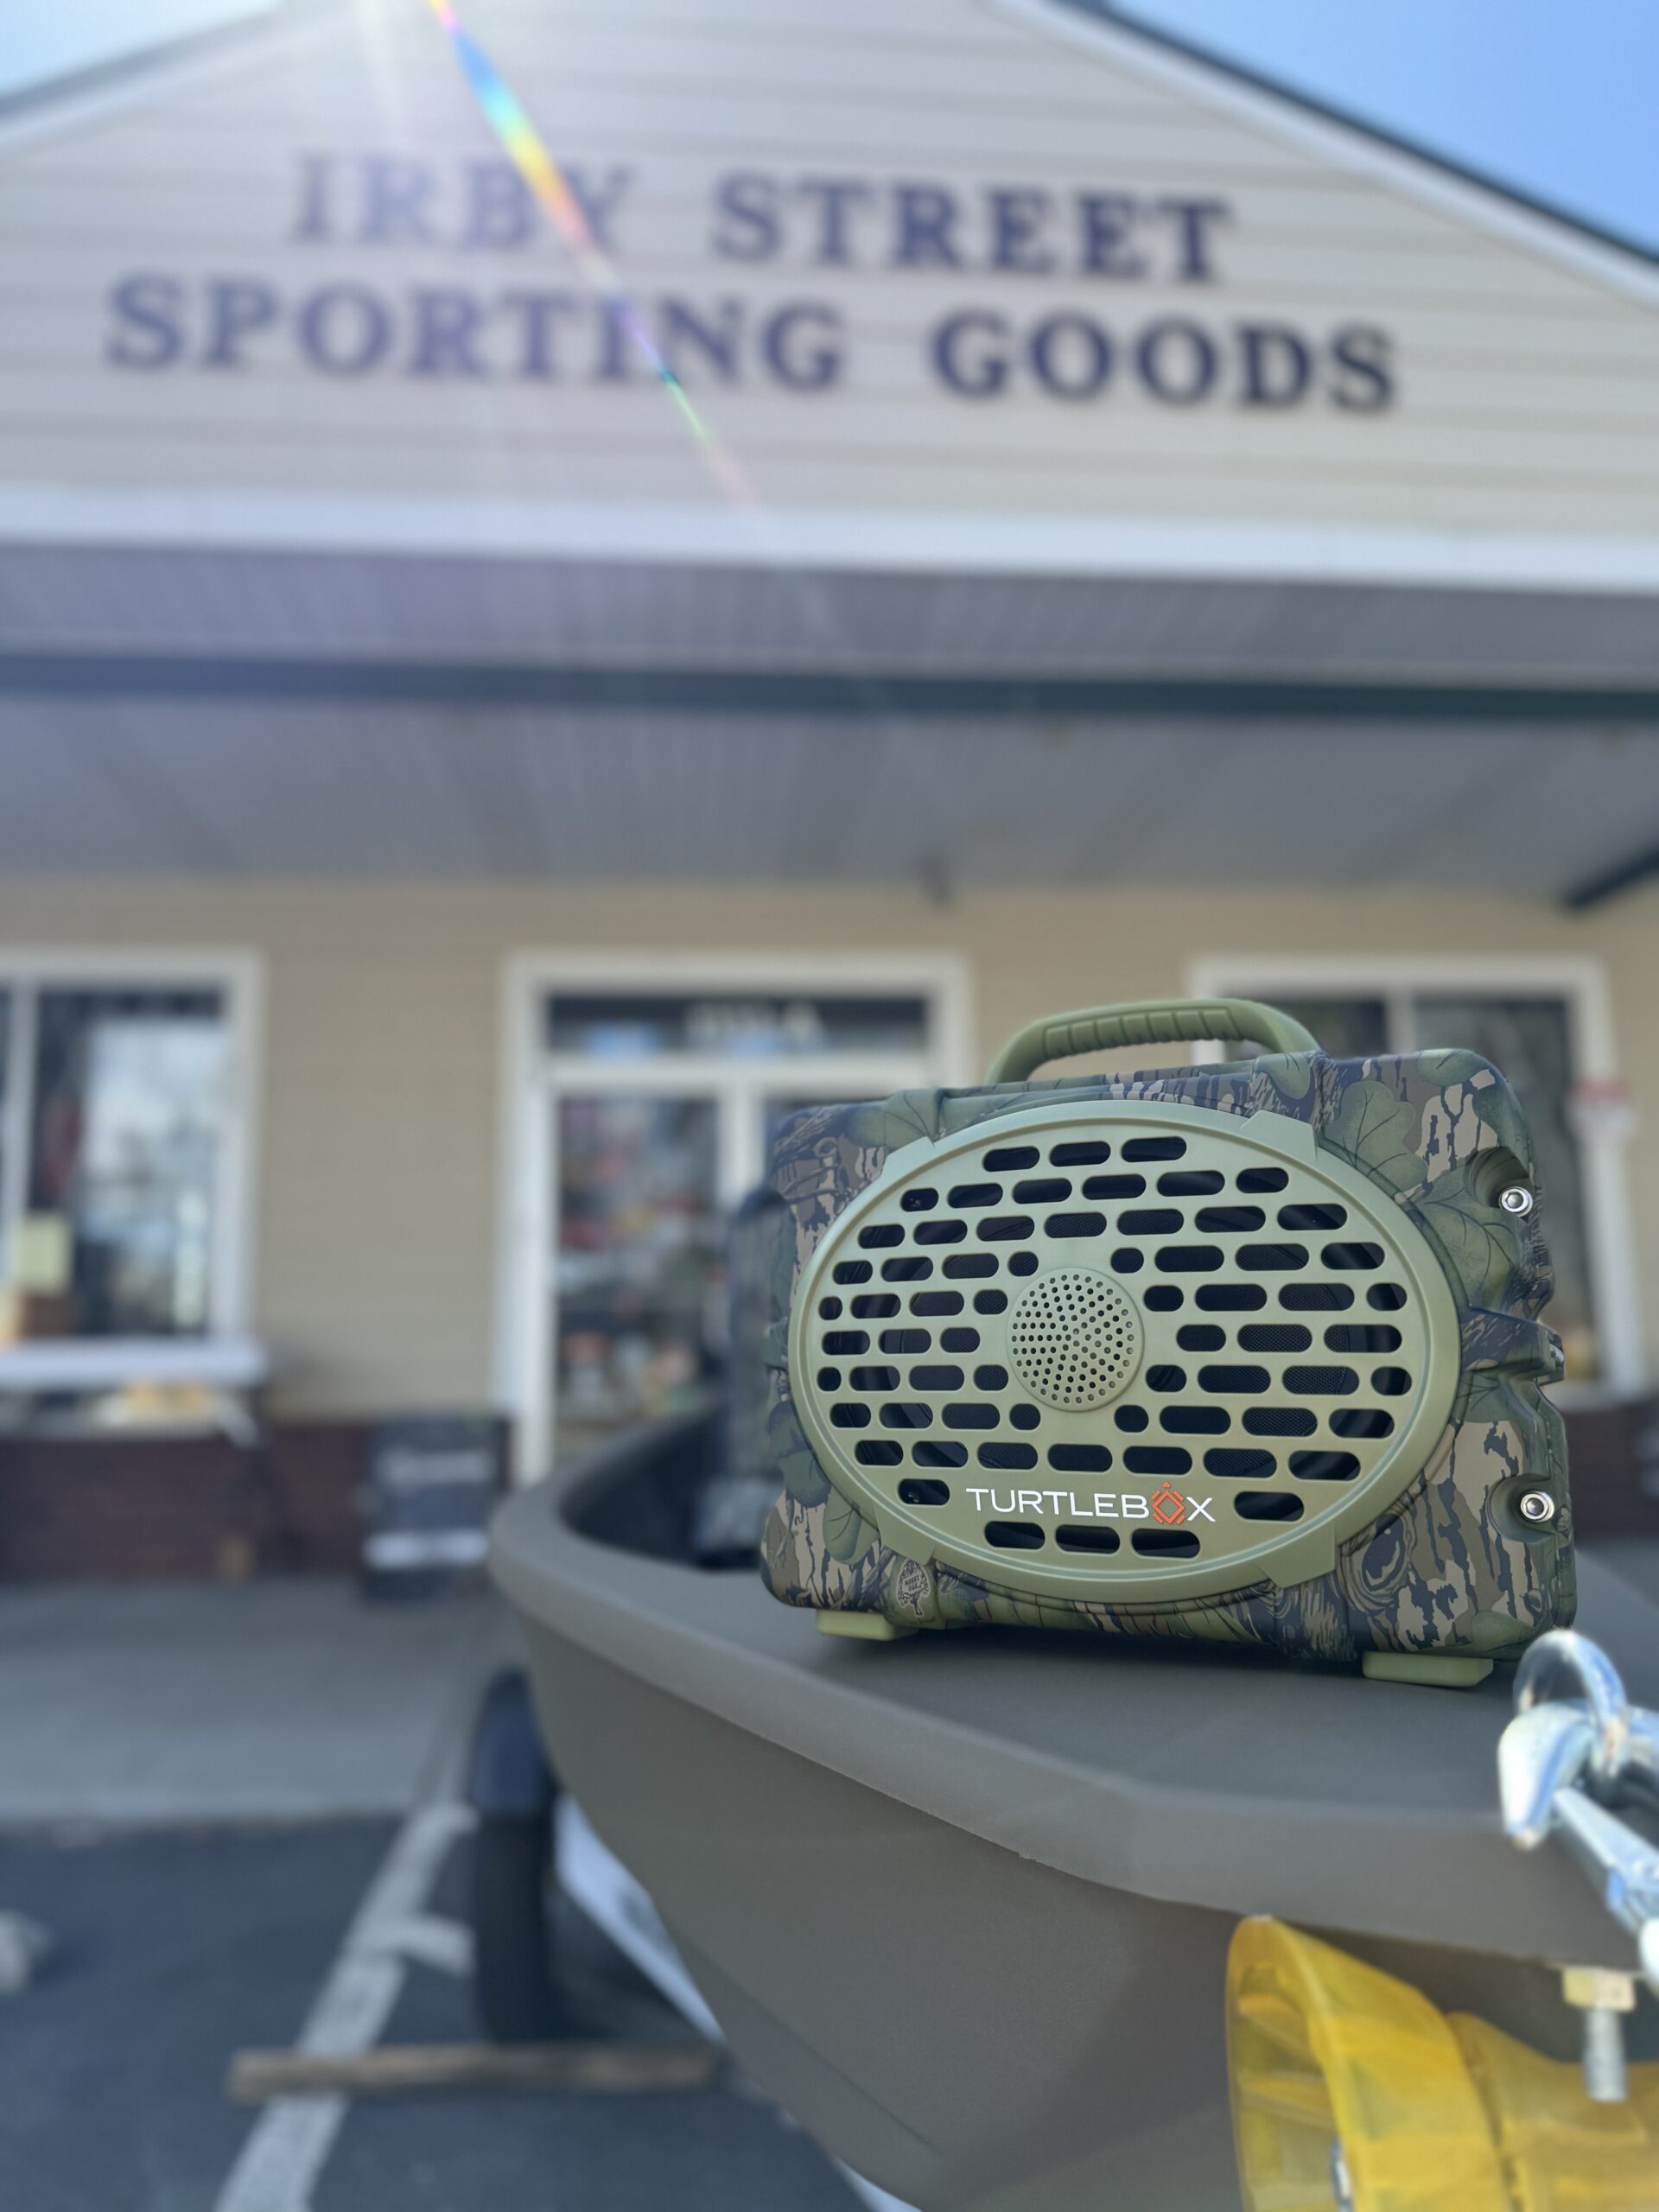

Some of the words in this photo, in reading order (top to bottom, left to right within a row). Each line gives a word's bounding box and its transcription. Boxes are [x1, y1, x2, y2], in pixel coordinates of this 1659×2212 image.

[292, 150, 638, 251] IRBY
[710, 169, 1232, 285] STREET
[105, 273, 845, 393] SPORTING
[930, 309, 1396, 415] GOODS
[966, 1481, 1216, 1525] TURTLEBOX
